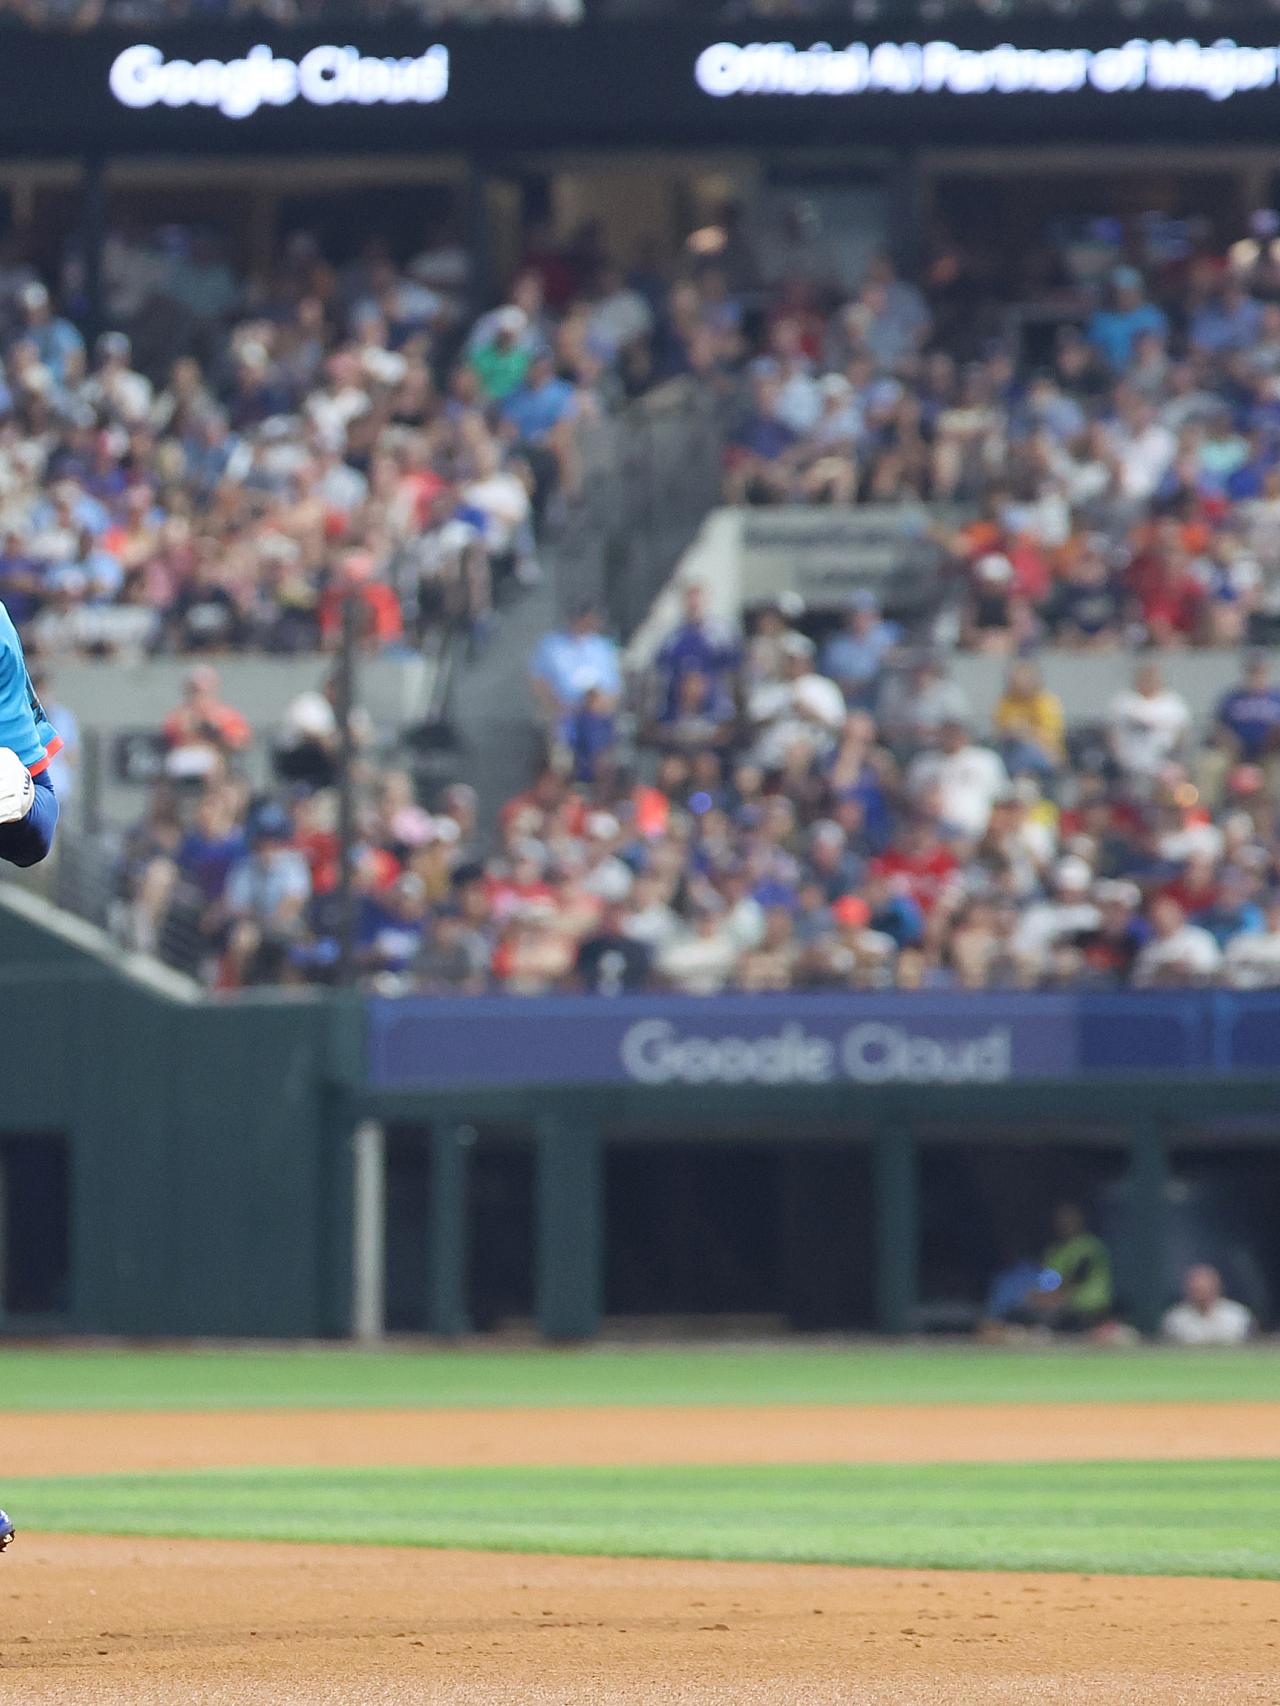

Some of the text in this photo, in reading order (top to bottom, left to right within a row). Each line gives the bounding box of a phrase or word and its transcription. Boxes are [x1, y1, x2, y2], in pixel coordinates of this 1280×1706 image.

[109, 44, 449, 119] Google Cloud
[695, 41, 869, 97] Official
[921, 40, 1087, 94] Partner
[1088, 38, 1147, 93] of
[1147, 38, 1276, 101] Major
[622, 1017, 1013, 1085] Google Cloud
